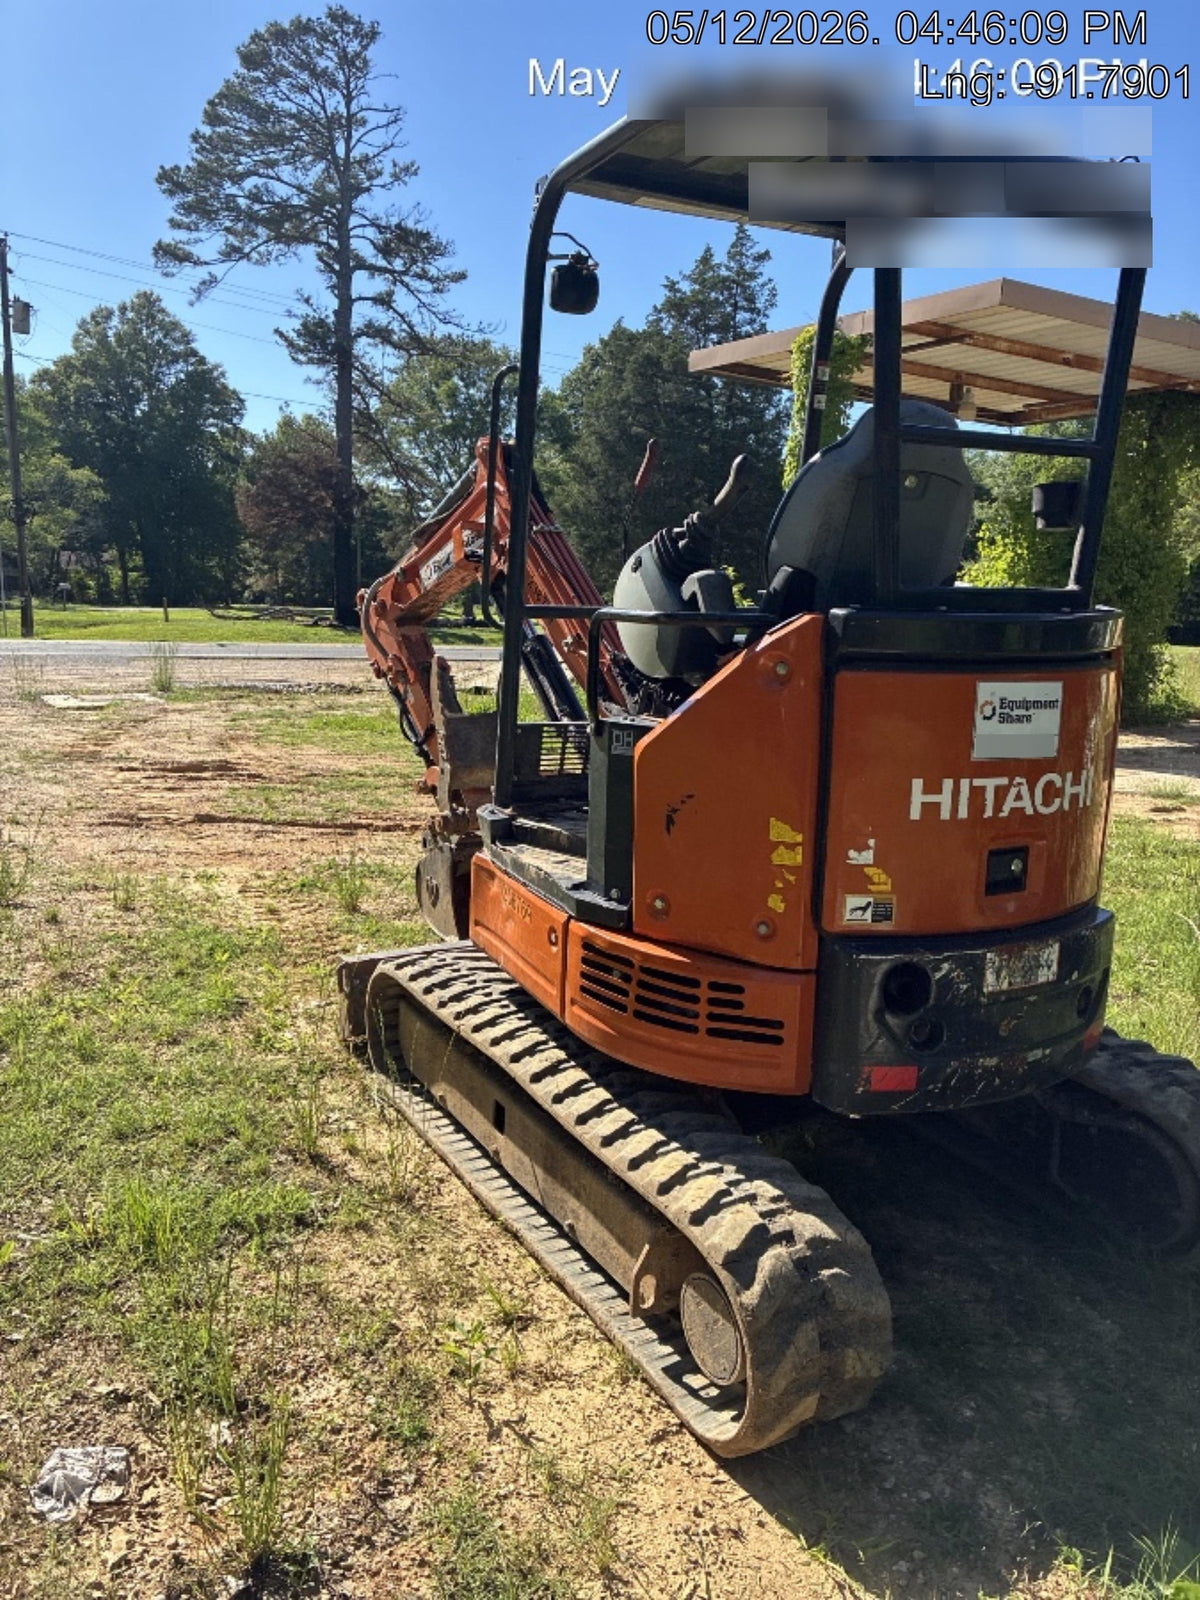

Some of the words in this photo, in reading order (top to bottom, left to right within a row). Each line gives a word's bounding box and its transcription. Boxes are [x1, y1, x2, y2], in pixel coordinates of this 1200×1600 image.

[998, 697, 1059, 711] Equipment
[998, 712, 1032, 724] Share
[909, 769, 1094, 820] HITACHI
